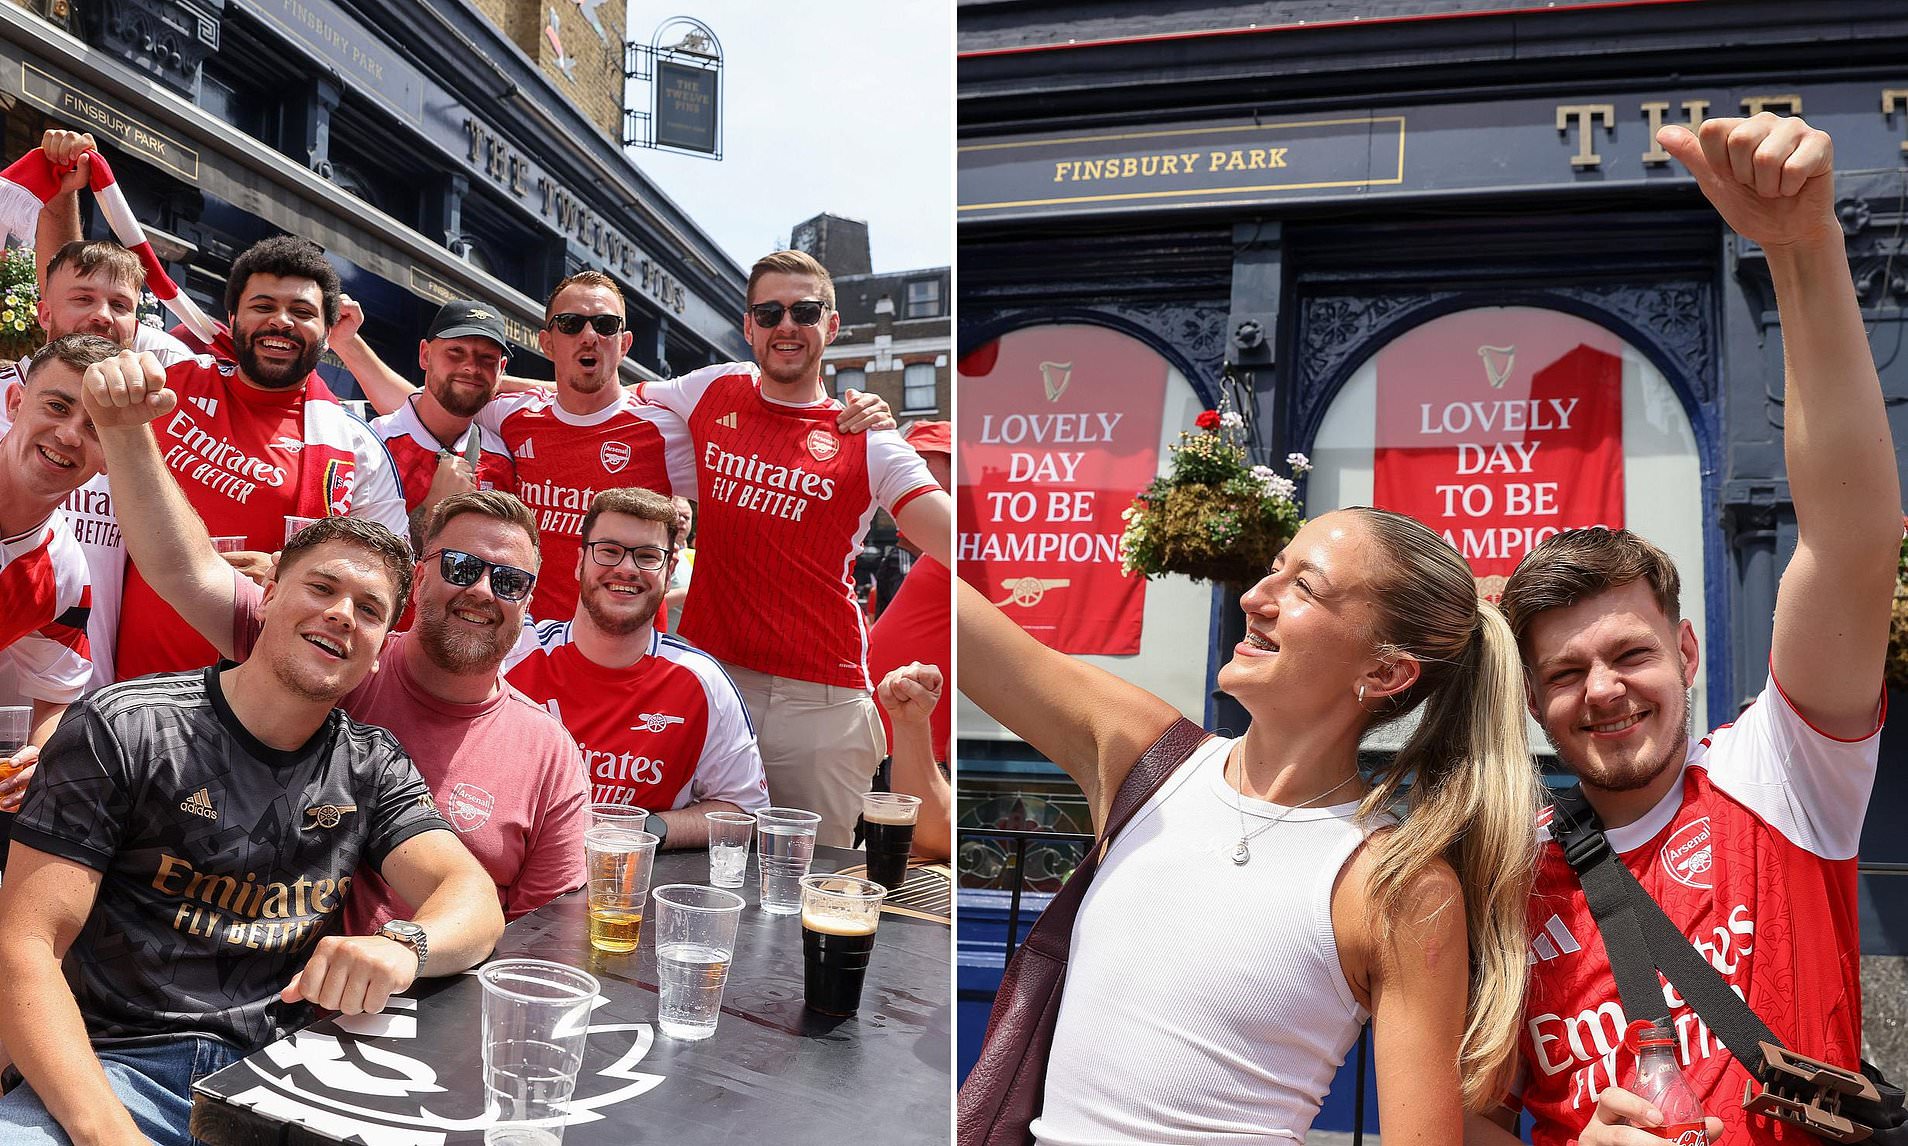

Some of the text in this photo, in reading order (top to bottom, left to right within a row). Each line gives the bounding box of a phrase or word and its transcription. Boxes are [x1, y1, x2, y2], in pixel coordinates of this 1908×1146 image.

[352, 46, 383, 80] PARK
[64, 94, 166, 156] FINSBURY PARK
[1053, 147, 1288, 182] FINSBURY PARK
[464, 117, 530, 198] THE
[538, 176, 635, 278] TWELVE
[503, 316, 520, 342] HE
[980, 412, 1124, 444] LOVELY
[1420, 398, 1579, 434] LOVELY
[166, 408, 288, 488] Emirates
[1456, 441, 1541, 475] DAY
[165, 444, 256, 505] FLY BETTER
[705, 441, 835, 501] Emirates
[1007, 452, 1086, 483] DAY
[712, 476, 808, 522] FLY BETTER
[987, 490, 1096, 523] TO BE
[1435, 482, 1559, 518] TO BE
[540, 510, 587, 535] BETTE
[957, 532, 1122, 563] HAMPION
[579, 742, 665, 785] irates
[180, 801, 218, 820] adidas
[459, 789, 490, 809] Arsenal
[1669, 826, 1711, 862] Arsenal
[173, 902, 222, 938] FLY
